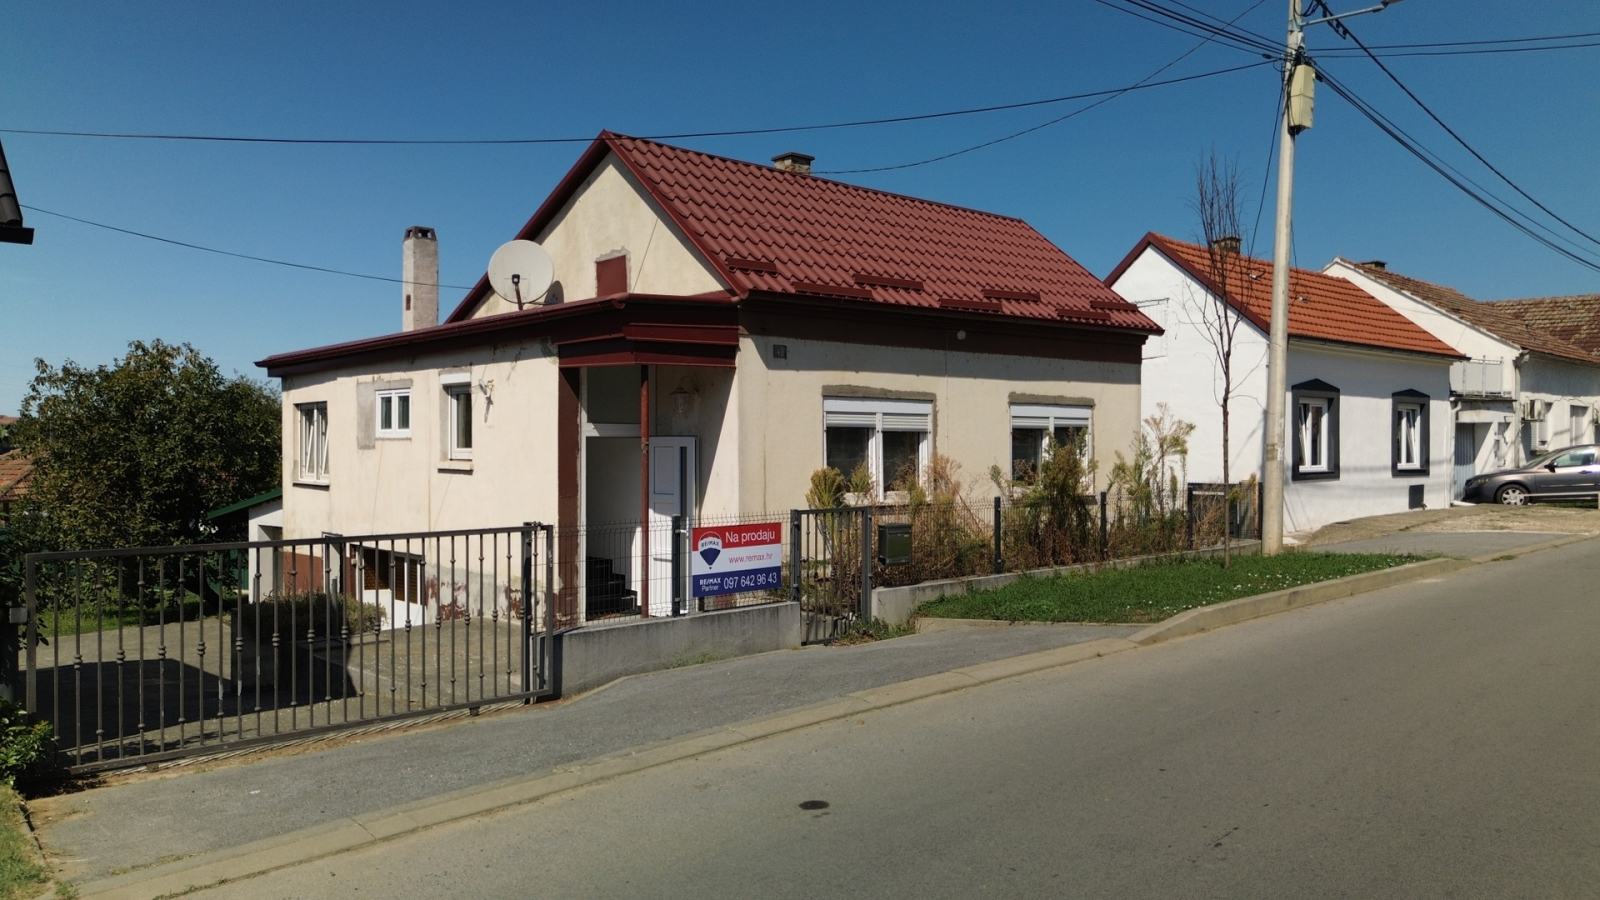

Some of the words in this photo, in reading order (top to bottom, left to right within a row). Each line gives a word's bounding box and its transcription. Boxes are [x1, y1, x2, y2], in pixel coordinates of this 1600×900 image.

[725, 532, 739, 543] Na
[742, 529, 775, 544] prodaju
[729, 553, 773, 563] www.remax.hr
[724, 577, 738, 589] 097
[741, 575, 754, 587] 642
[757, 574, 766, 585] 96
[768, 572, 777, 583] 43
